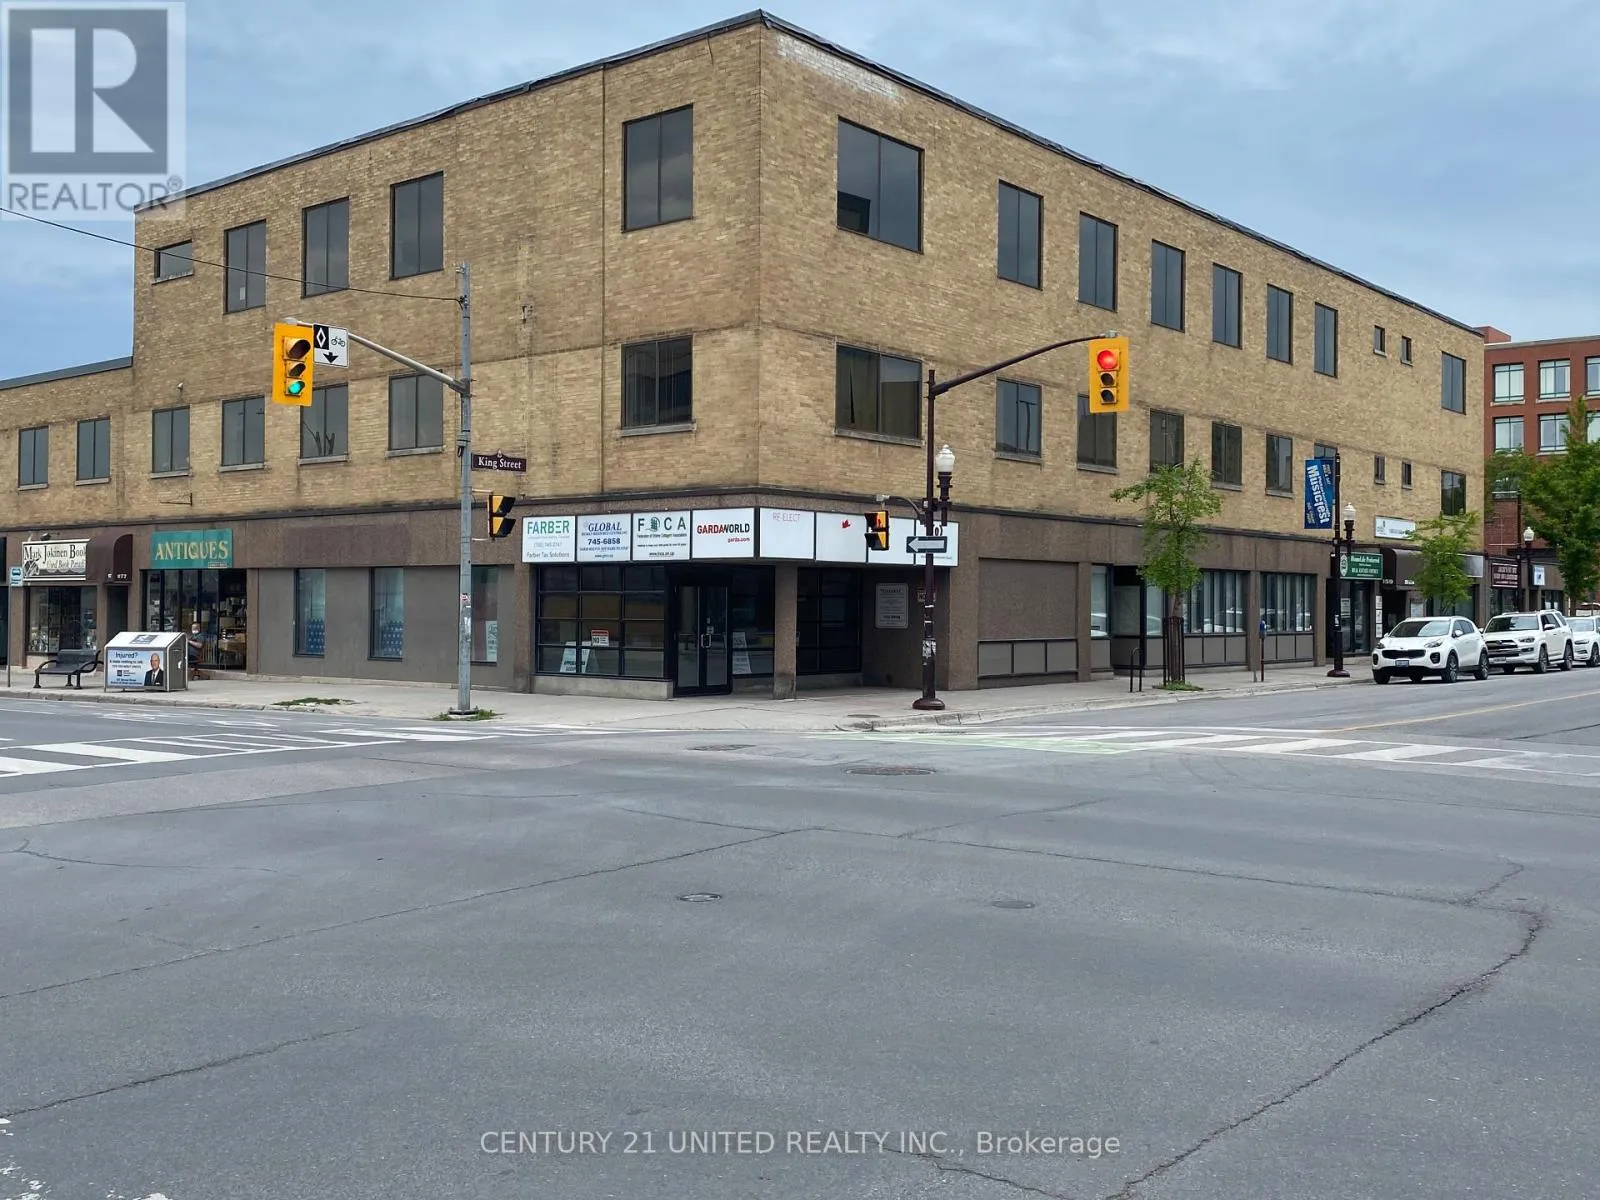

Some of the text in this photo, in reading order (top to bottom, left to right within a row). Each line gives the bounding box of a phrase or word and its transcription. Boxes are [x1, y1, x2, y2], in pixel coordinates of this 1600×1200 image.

[478, 456, 522, 469] King Street
[1306, 464, 1330, 524] Musicfest
[527, 520, 570, 534] FARBER
[588, 522, 622, 532] GLOBAL
[696, 523, 750, 534] GARDAWORLD
[24, 546, 42, 560] Mark
[43, 545, 67, 564] Jokinen
[155, 540, 229, 560] ANTIQUES
